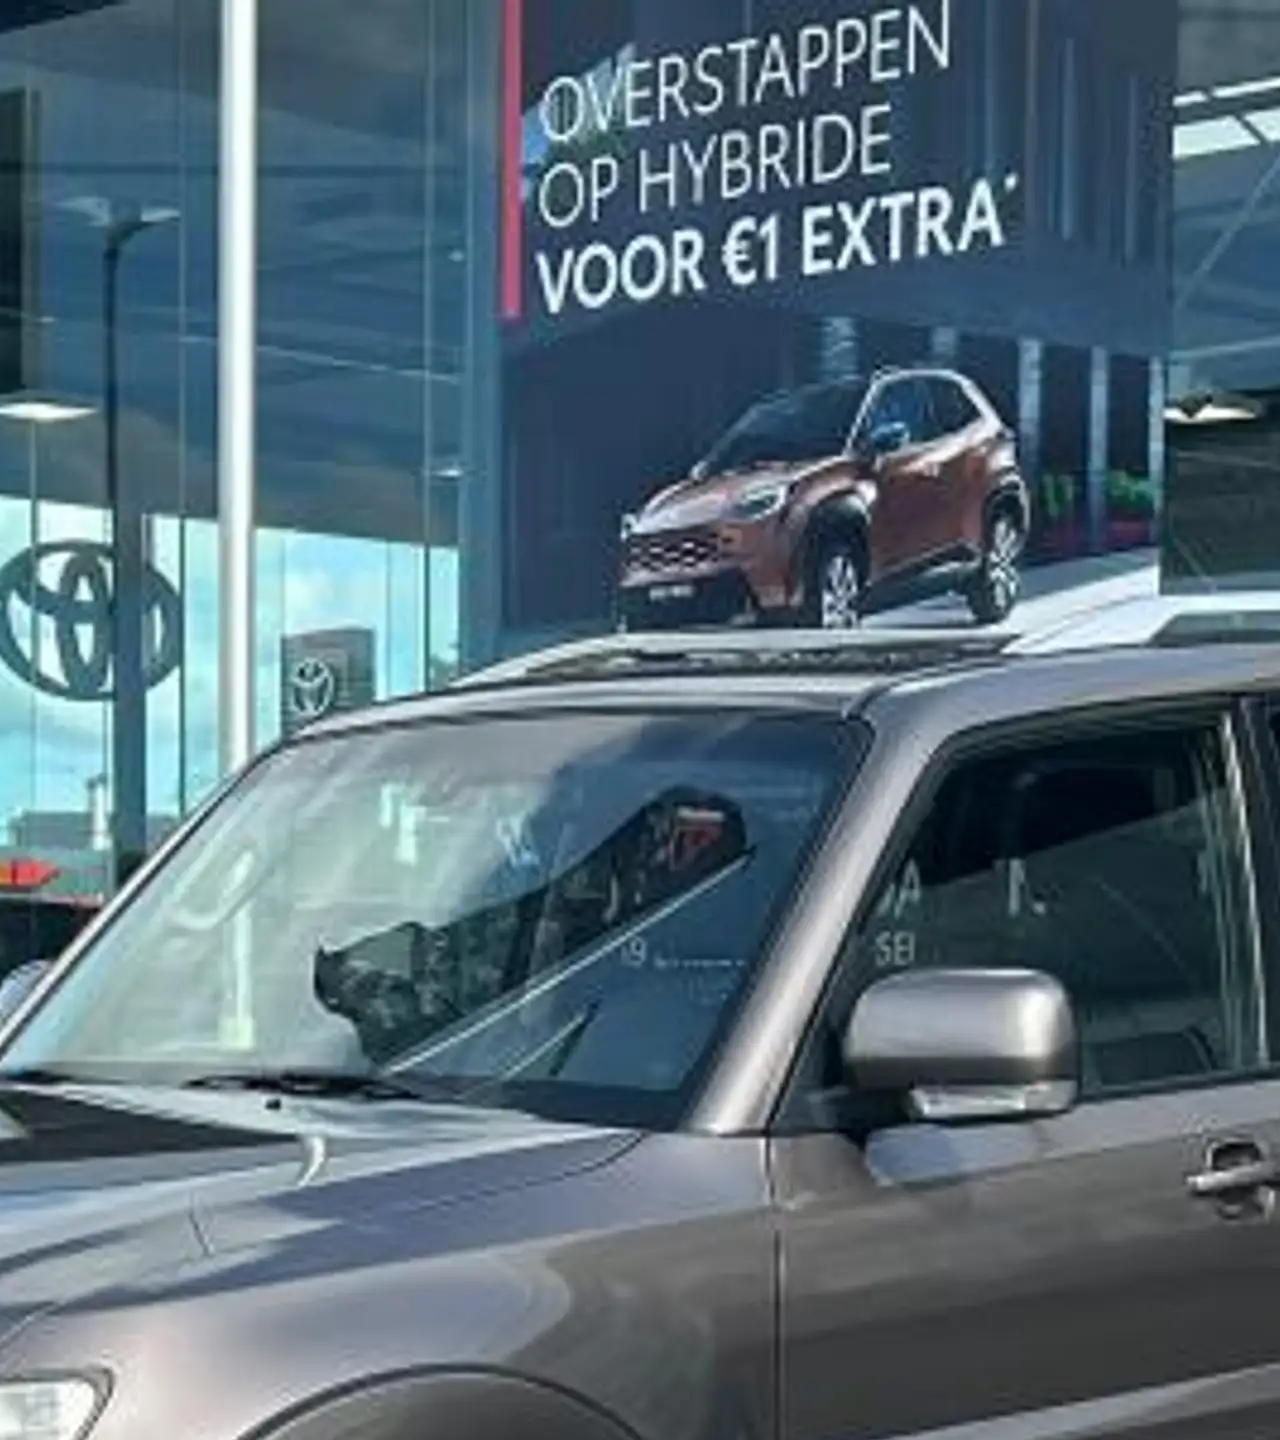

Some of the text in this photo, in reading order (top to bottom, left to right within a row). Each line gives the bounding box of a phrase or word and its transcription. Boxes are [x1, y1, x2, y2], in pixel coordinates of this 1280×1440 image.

[539, 0, 950, 142] OVERSTAPPEN
[538, 104, 892, 228] OP HYBRIDE
[535, 227, 705, 315] VOOR
[721, 213, 780, 286] €1
